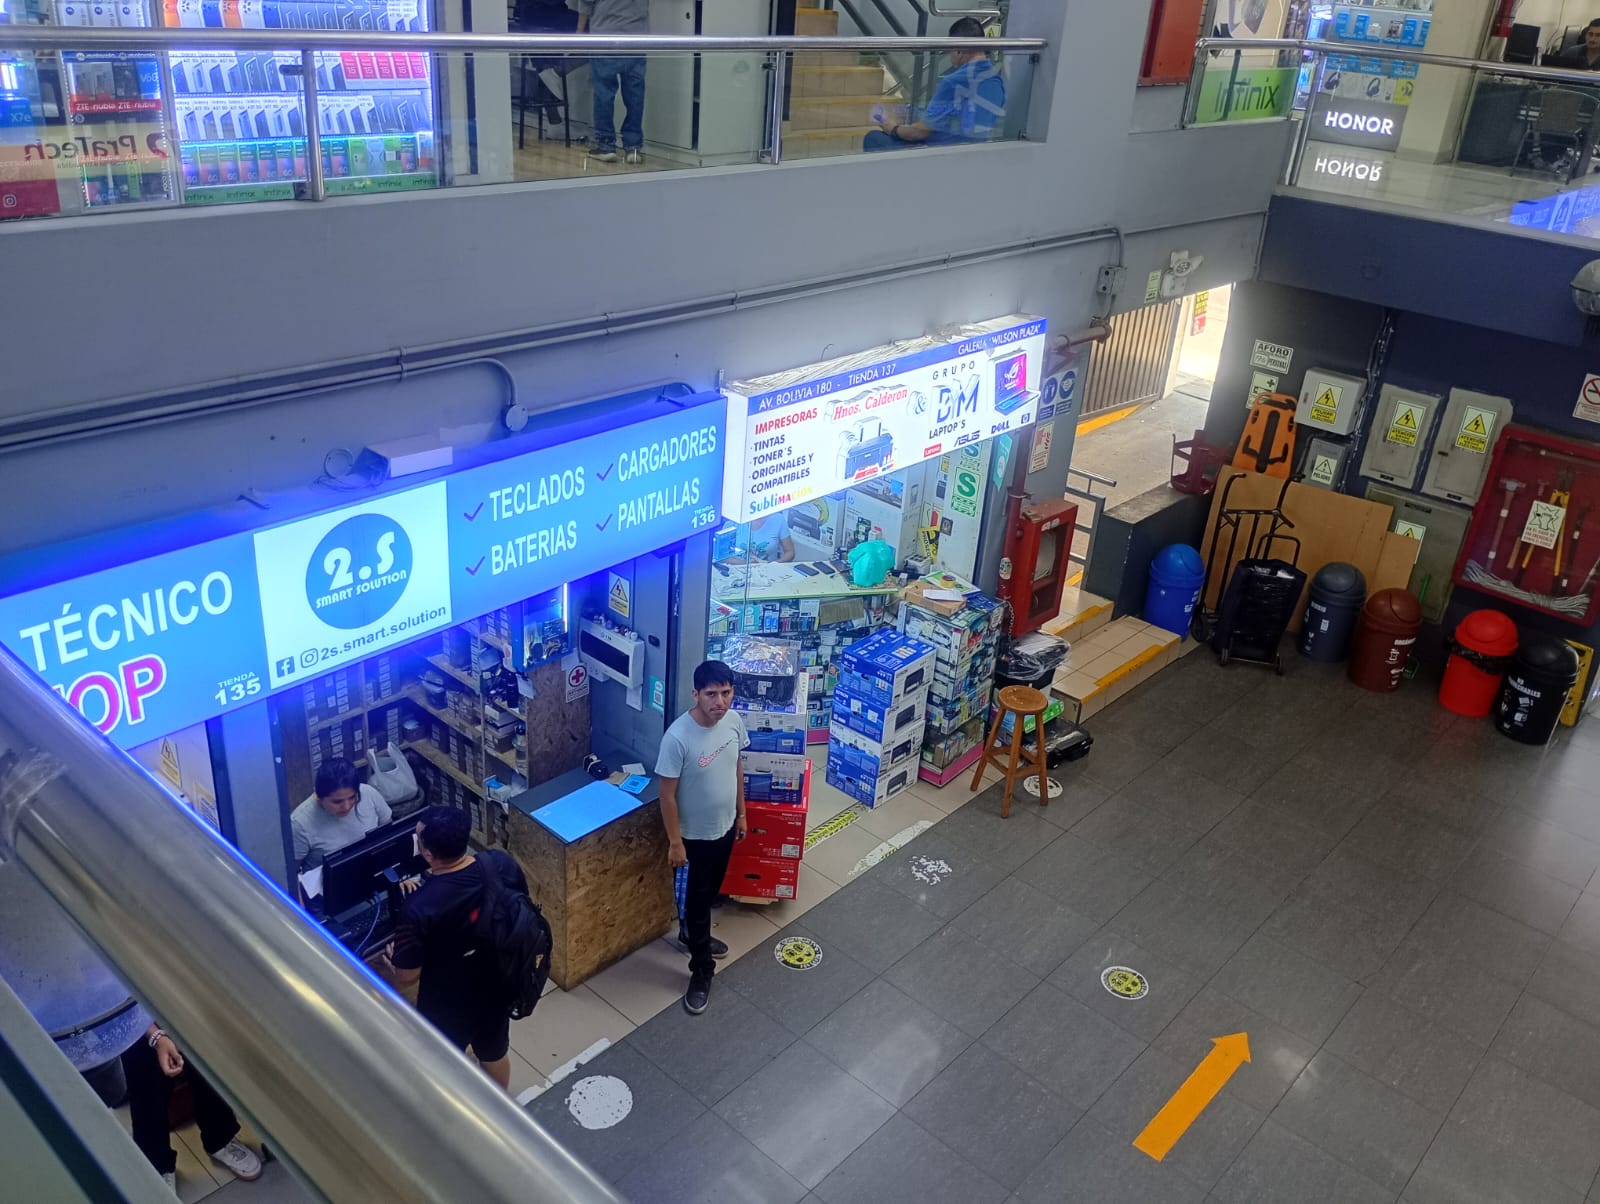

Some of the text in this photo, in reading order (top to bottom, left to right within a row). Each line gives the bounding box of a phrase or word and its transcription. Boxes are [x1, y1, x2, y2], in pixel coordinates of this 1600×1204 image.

[1324, 111, 1394, 136] HONOR
[1257, 343, 1290, 356] AFORO
[816, 383, 832, 394] 180
[848, 367, 879, 385] TIENDA
[880, 363, 897, 378] 137
[932, 360, 976, 381] GRUPO
[833, 404, 862, 421] Hnos.
[864, 388, 908, 411] Calderon
[754, 407, 818, 435] IMPRESORAS
[753, 434, 786, 452] TINTAS
[953, 430, 981, 447] ASUS
[618, 424, 717, 482] CARGADORES
[751, 453, 815, 480] ORIGINALES Y
[489, 465, 585, 522] TECLADOS
[750, 467, 811, 494] COMPATIBLES
[957, 472, 976, 498] S
[617, 476, 700, 532] PANTALLAS
[691, 510, 715, 529] 136
[491, 520, 577, 576] BATERIAS
[315, 587, 353, 609] SMART
[19, 570, 233, 673] TÉCNICO
[320, 605, 447, 662] 2s.smart.solution
[214, 676, 262, 706] 135
[217, 671, 256, 689] TIENDA
[54, 653, 167, 737] OP
